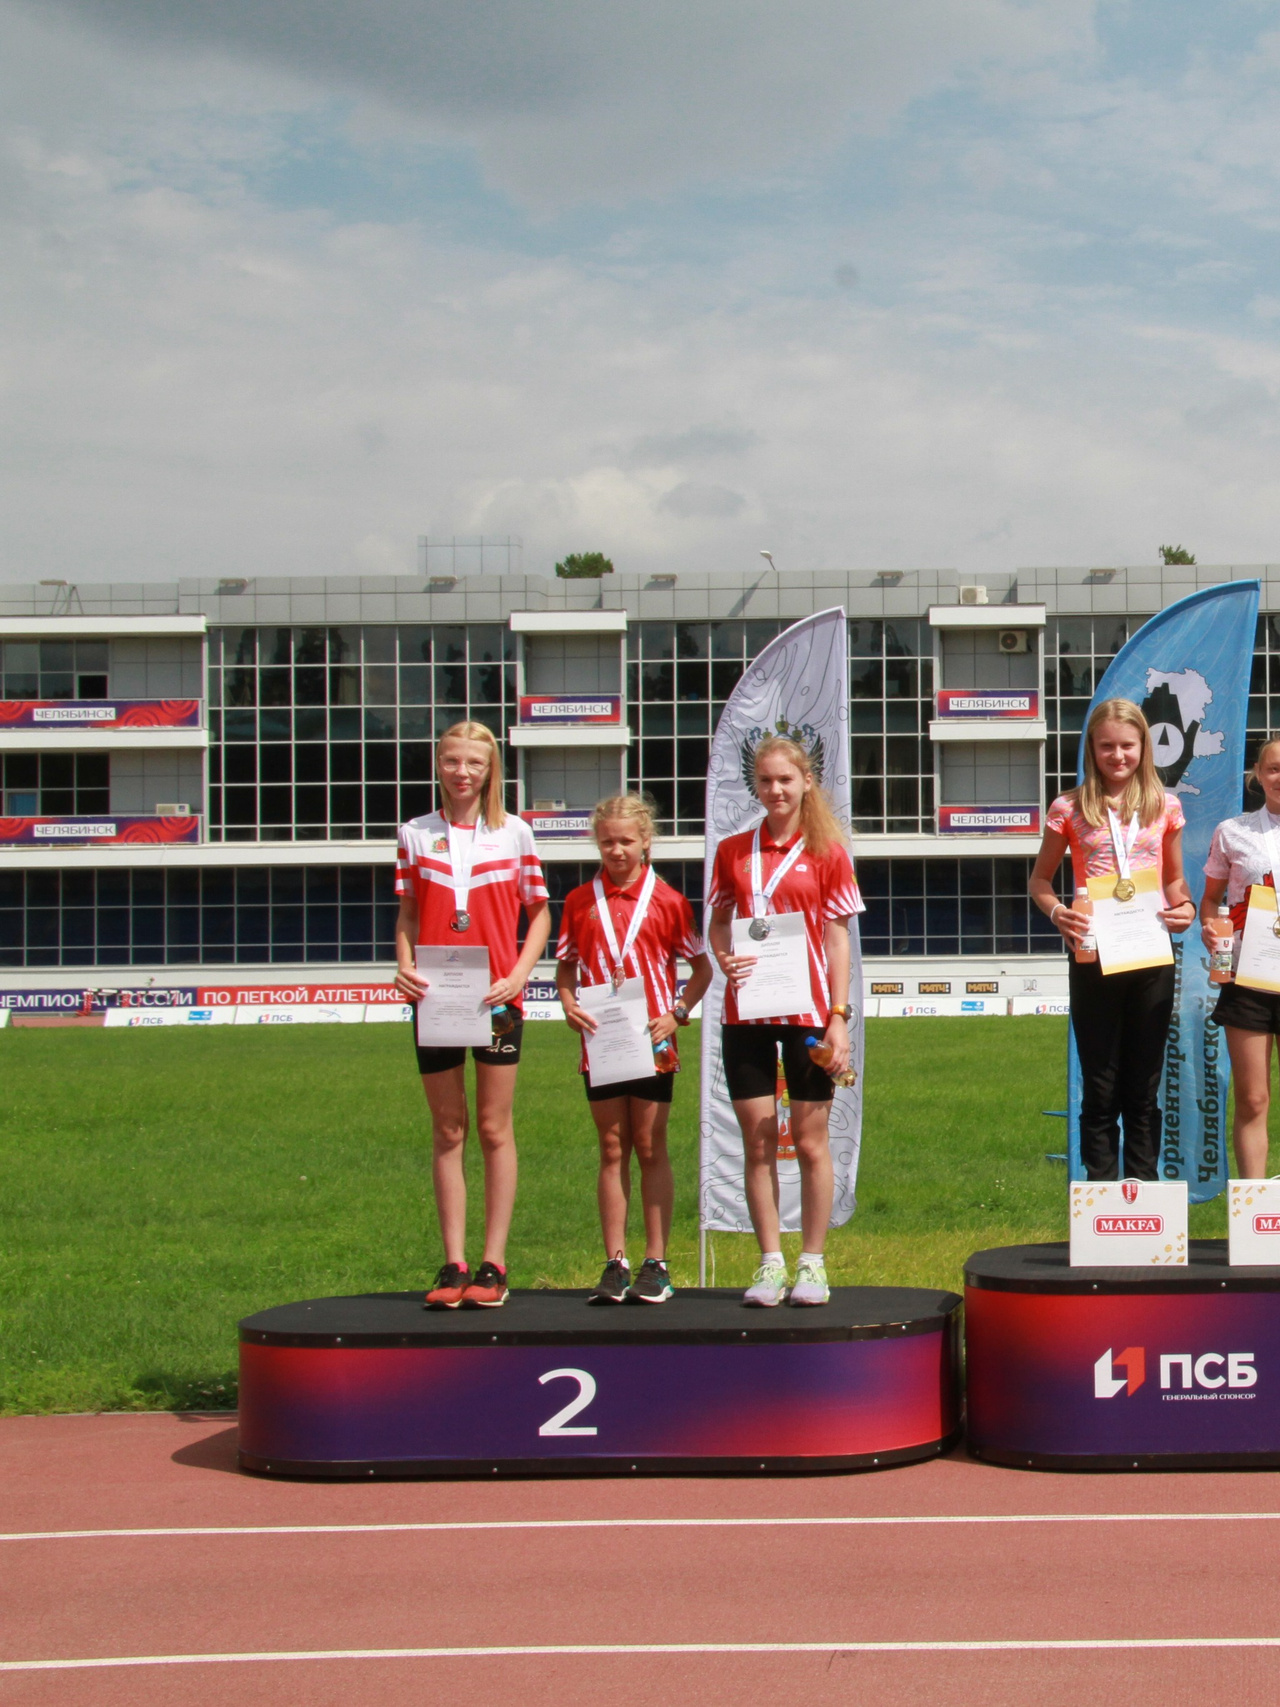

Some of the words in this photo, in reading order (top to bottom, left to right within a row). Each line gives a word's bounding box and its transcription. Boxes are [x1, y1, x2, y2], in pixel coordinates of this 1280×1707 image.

[533, 704, 610, 714] ЧЕЛЯБИНСК
[951, 699, 1027, 709] ЧЕЛЯБИНСК
[35, 708, 114, 719] ЧЕЛЯБИНСК
[952, 815, 1028, 824] ЧЕЛЯБИНСК
[36, 825, 114, 835] ЧЕЛЯБИНСК
[203, 991, 231, 1005] ПО
[235, 986, 309, 1004] ЛЕГКОЙ
[313, 988, 406, 1003] АТЛЕТИКЕ
[530, 1010, 551, 1018] ПСБ
[915, 1006, 937, 1014] ПСБ
[1049, 1005, 1070, 1013] ПСБ
[142, 1017, 164, 1025] ПСБ
[271, 1014, 293, 1022] ПСБ
[1100, 1219, 1157, 1231] MAKFA
[1159, 1352, 1258, 1389] ПСБ
[538, 1367, 598, 1436] 2
[1161, 1392, 1218, 1401] ГЕНЕРАЛЬНЫЙ
[1219, 1392, 1257, 1400] СПОНСОР
